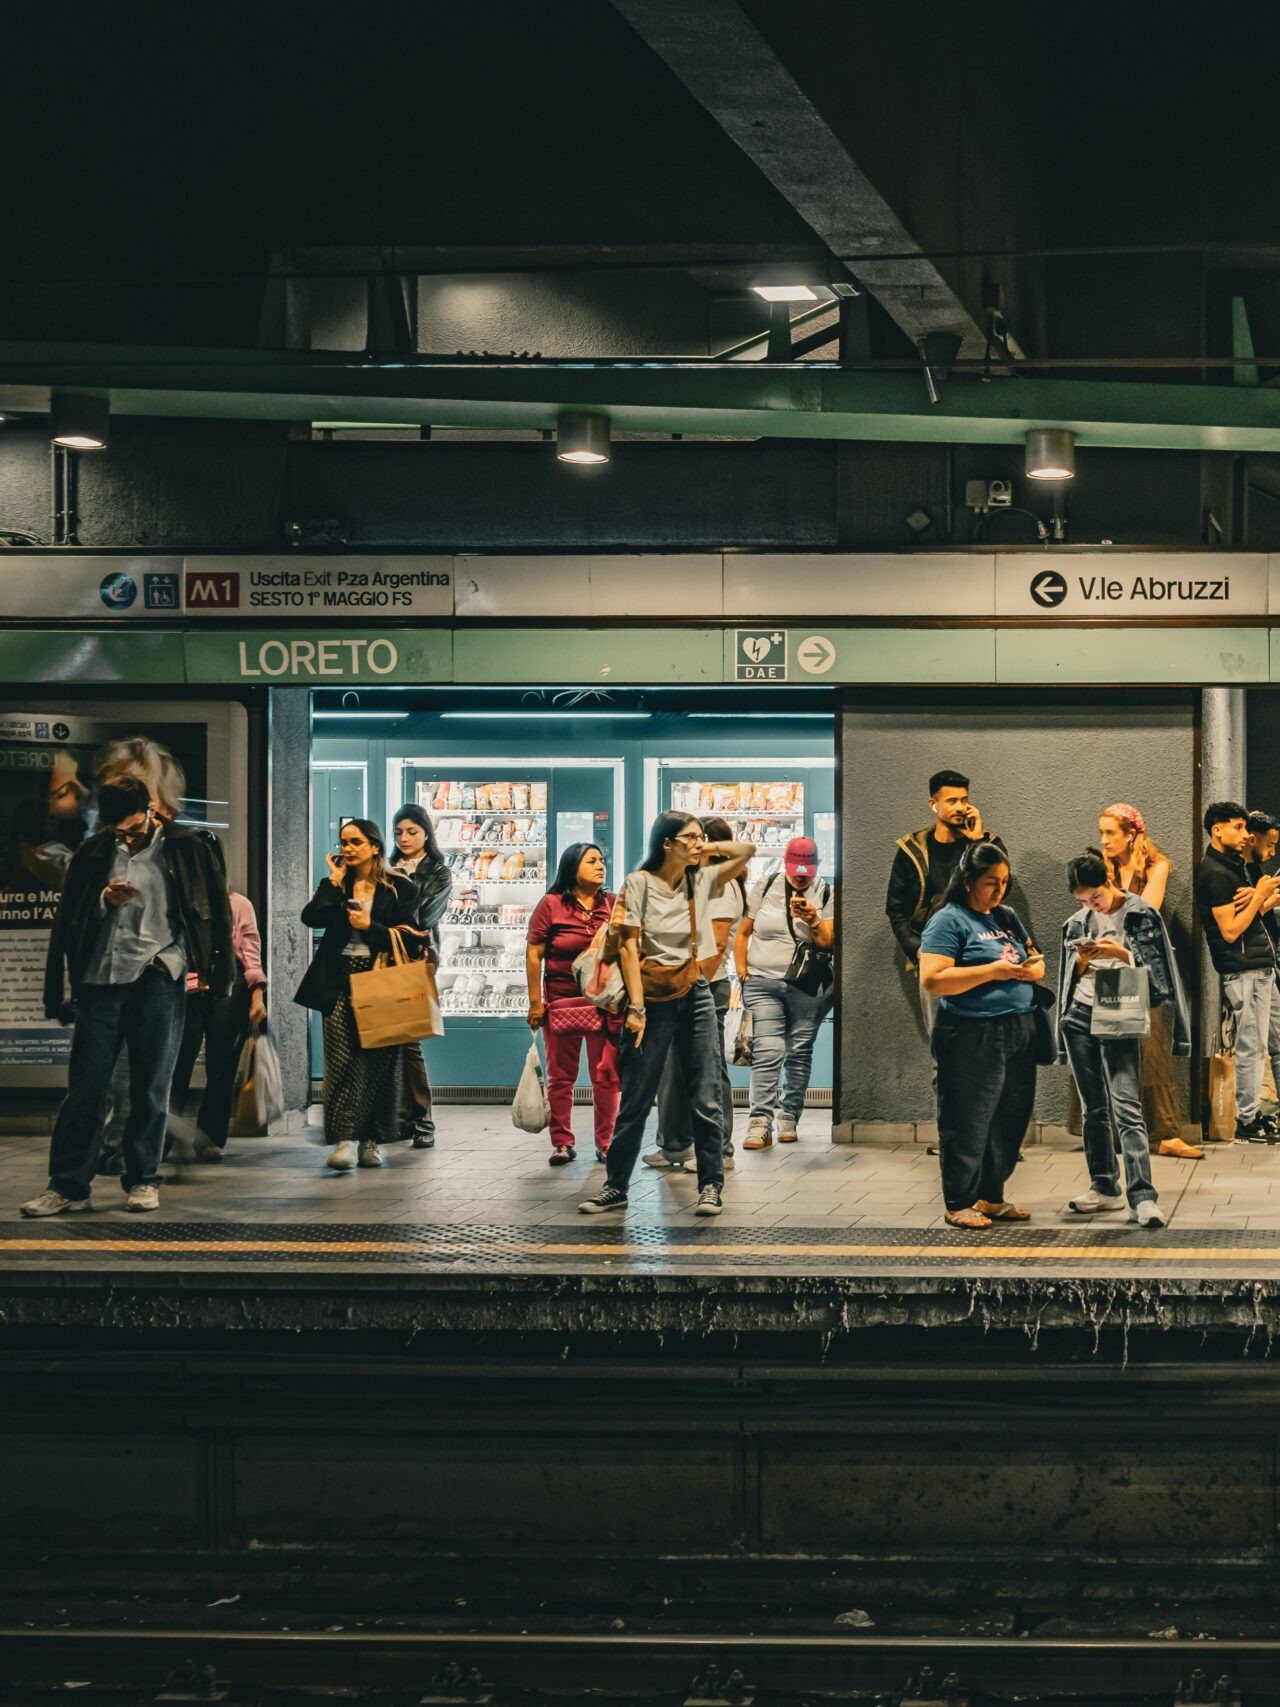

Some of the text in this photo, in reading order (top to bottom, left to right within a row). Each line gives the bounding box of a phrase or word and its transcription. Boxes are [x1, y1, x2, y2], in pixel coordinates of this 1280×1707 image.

[250, 571, 450, 588] Uscita Exit P.za Argentina
[189, 579, 232, 602] M1
[1078, 576, 1230, 601] V.le Abruzzi
[250, 591, 304, 607] SESTO
[323, 591, 389, 607] MAGGIO
[392, 591, 413, 606] FS
[239, 638, 398, 676] LORETO
[745, 667, 777, 679] DAE
[27, 892, 37, 903] e
